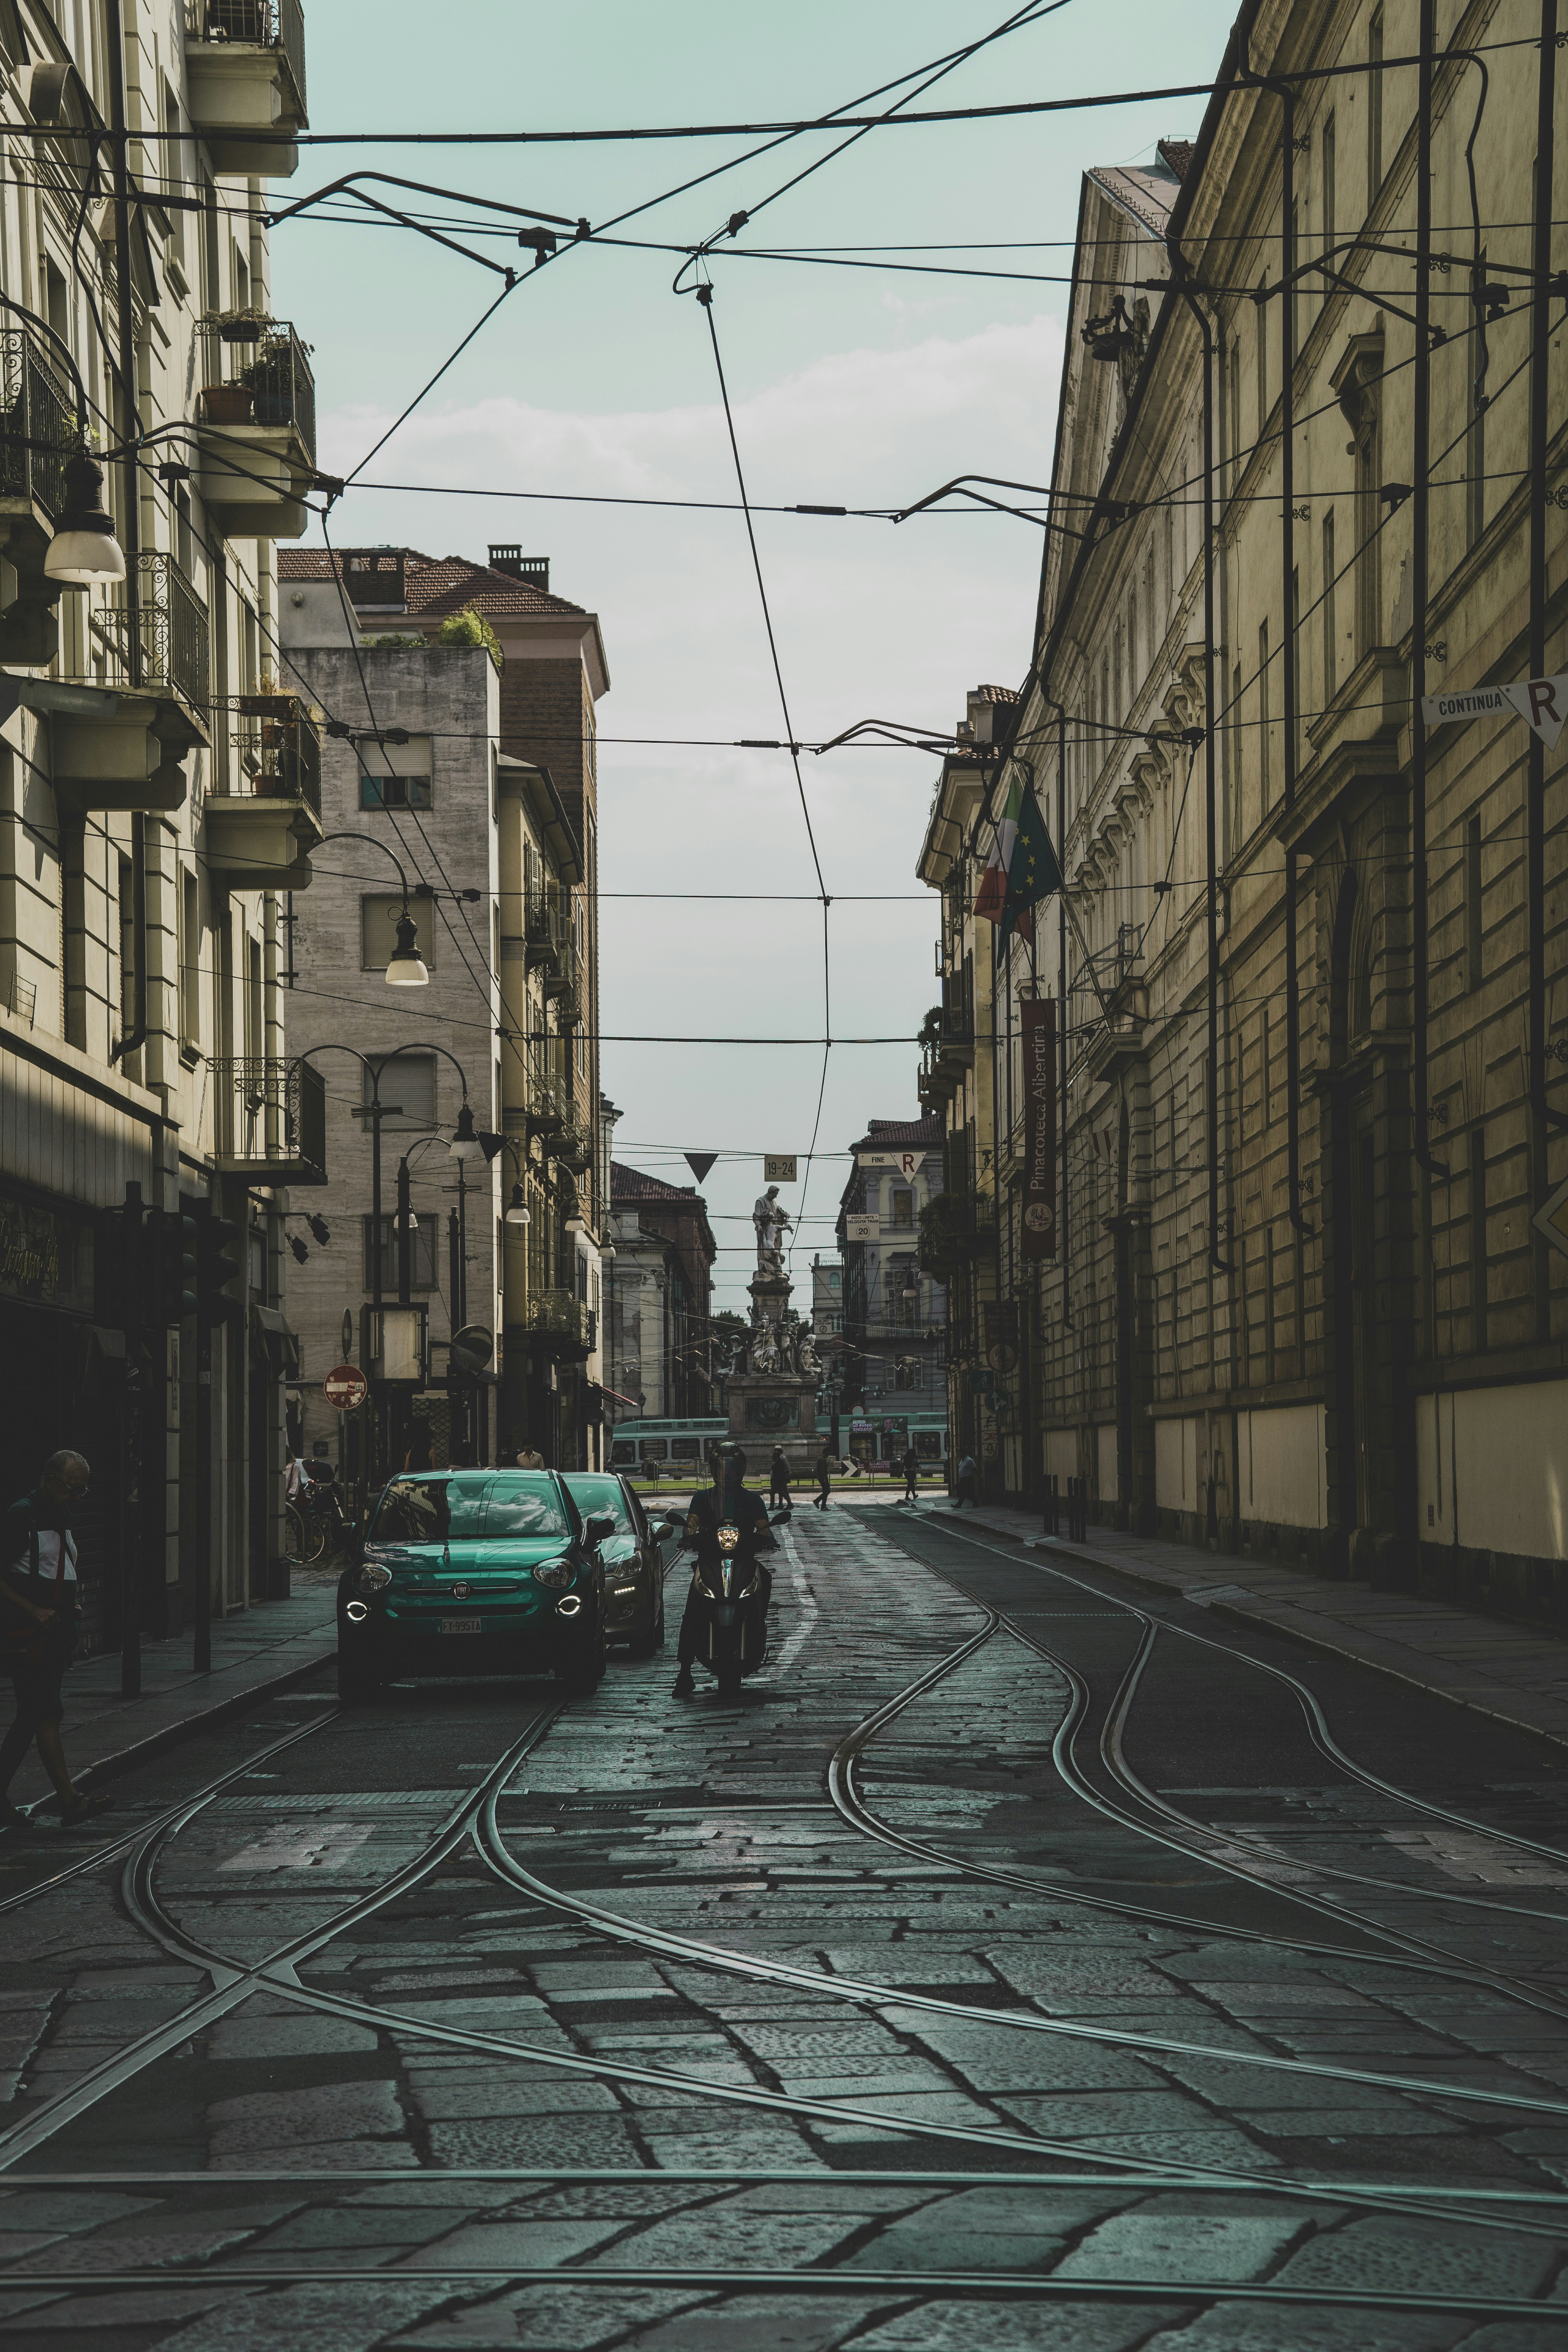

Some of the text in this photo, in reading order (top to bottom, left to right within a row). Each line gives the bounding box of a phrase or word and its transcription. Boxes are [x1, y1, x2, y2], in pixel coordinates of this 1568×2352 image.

[1439, 681, 1562, 727] CONTINUA R
[1030, 1025, 1046, 1189] Pinacoteca Albertina
[767, 1162, 794, 1175] 19-24
[902, 1154, 915, 1172] R
